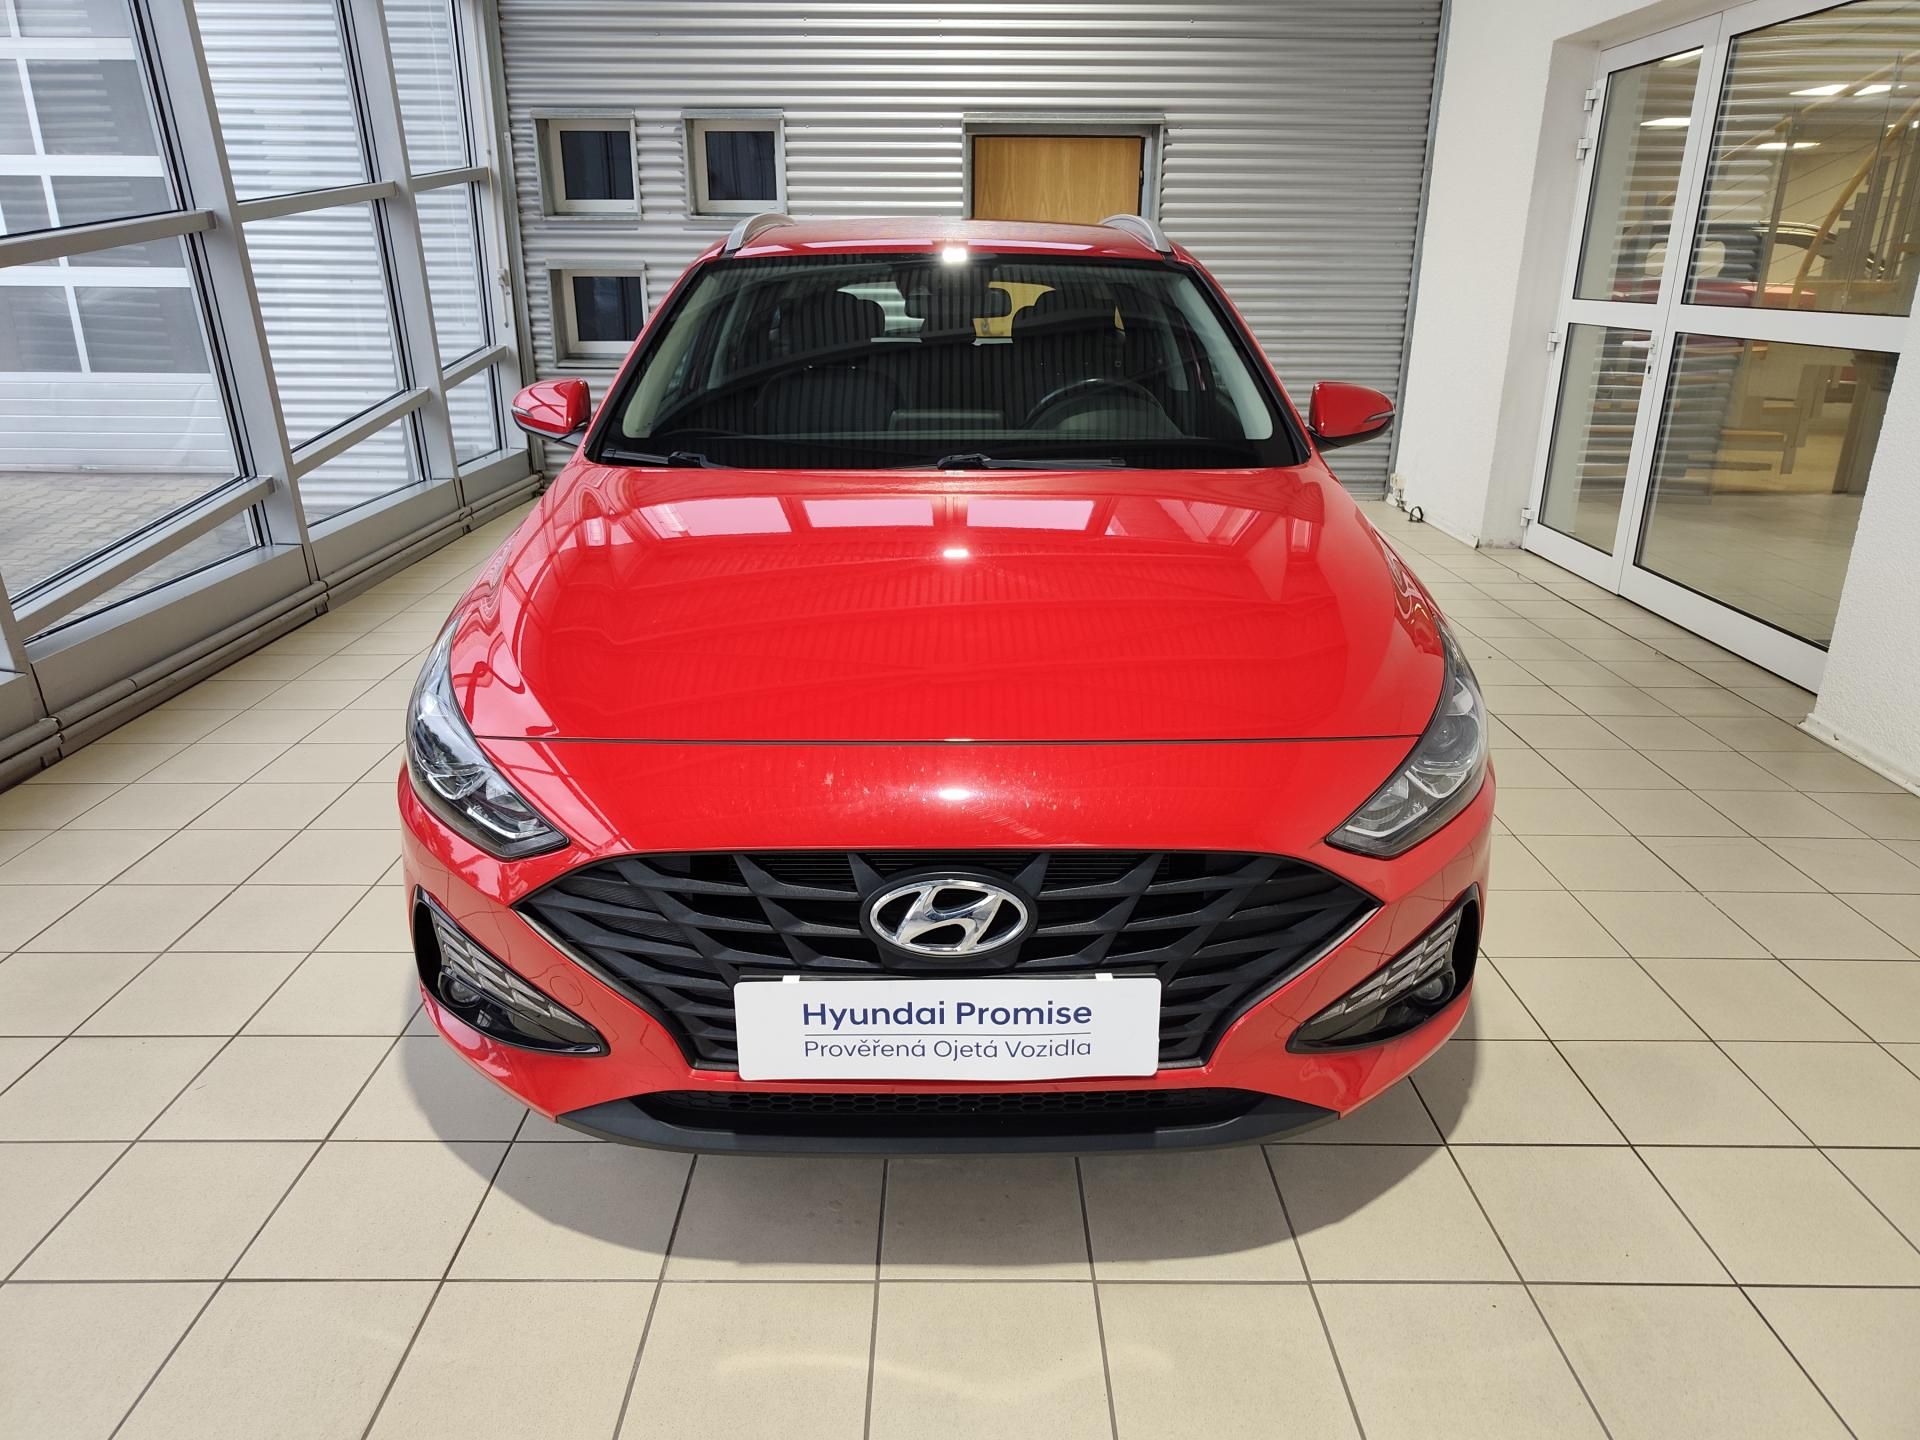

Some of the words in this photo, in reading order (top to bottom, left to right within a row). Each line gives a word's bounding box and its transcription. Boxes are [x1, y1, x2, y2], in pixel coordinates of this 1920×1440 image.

[802, 1000, 946, 1031] Hyundai
[956, 1000, 1092, 1026] Promise
[804, 1038, 926, 1058] Prověřená
[933, 1038, 998, 1062] Ojetá
[1004, 1038, 1091, 1059] Vozidla
